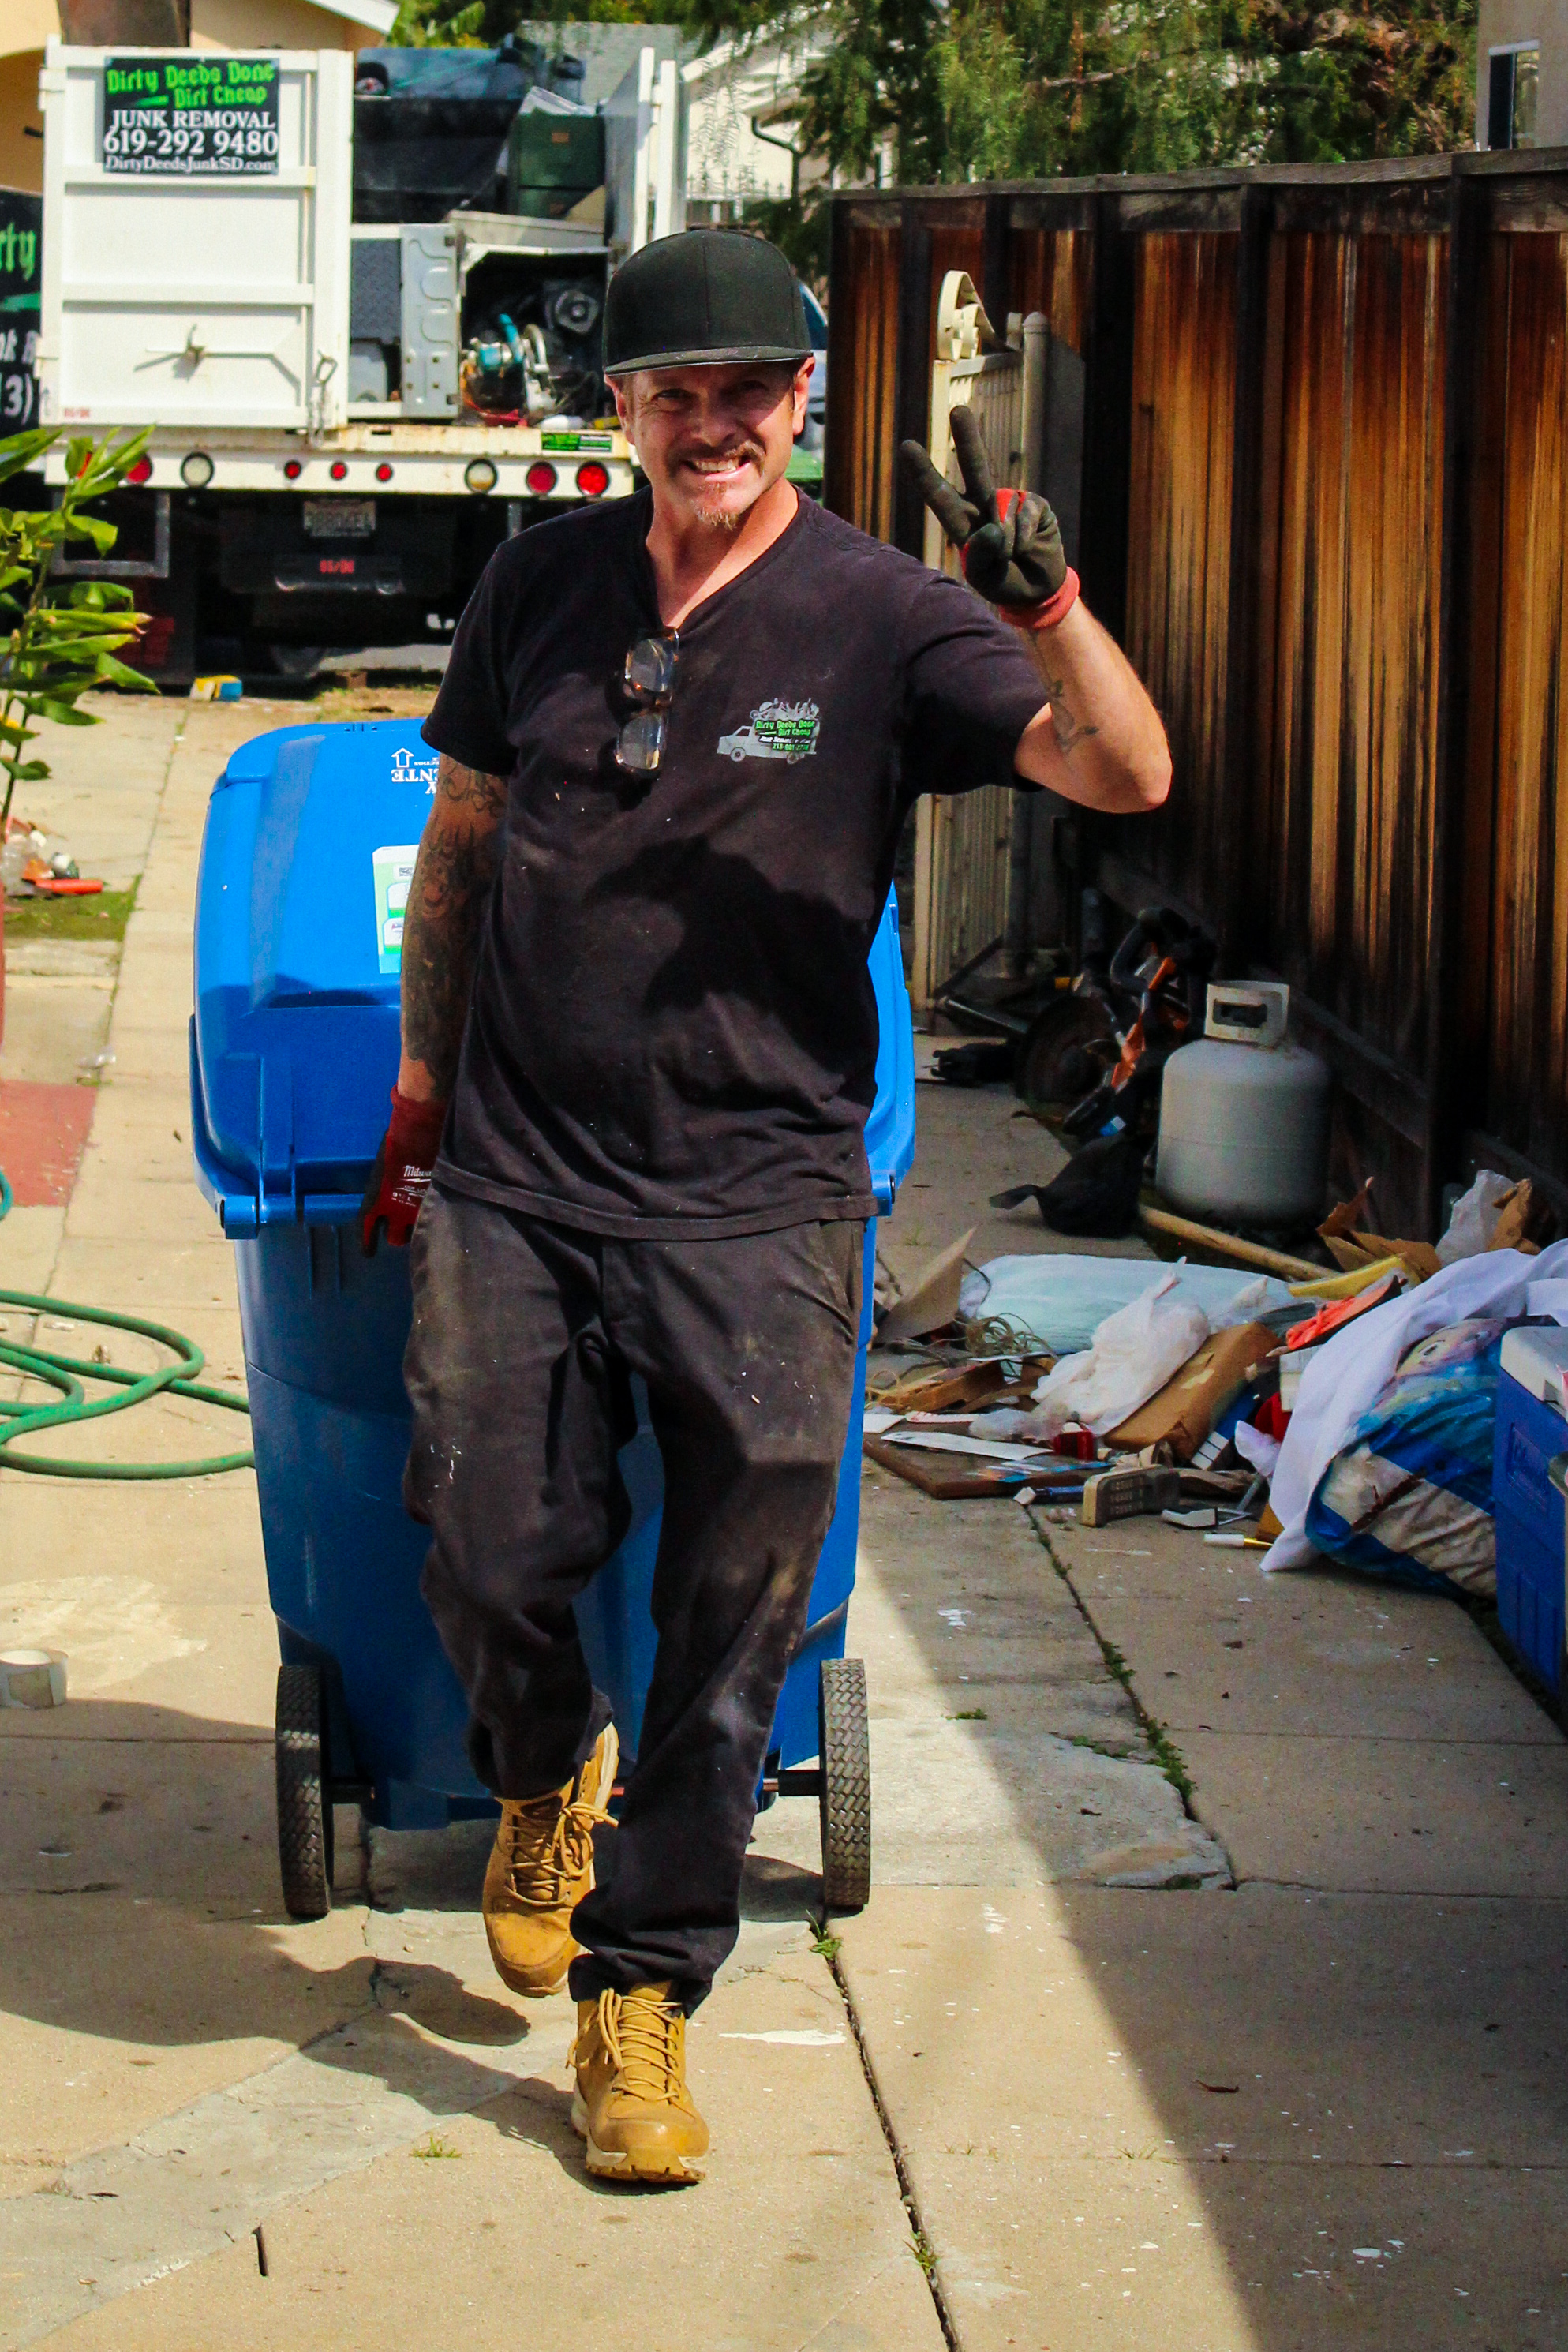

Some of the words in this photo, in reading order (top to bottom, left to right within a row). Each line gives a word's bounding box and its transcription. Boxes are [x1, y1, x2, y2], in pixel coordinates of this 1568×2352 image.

[107, 69, 159, 94] Dirty
[227, 60, 275, 84] Done
[174, 86, 208, 109] Dirt
[212, 85, 268, 106] Cheap
[110, 110, 168, 130] JUNK
[173, 110, 275, 129] REMOVAL
[103, 129, 205, 155] 619-292
[213, 130, 279, 155] 9480
[105, 155, 277, 173] DirtyDeedsJunkSD.com
